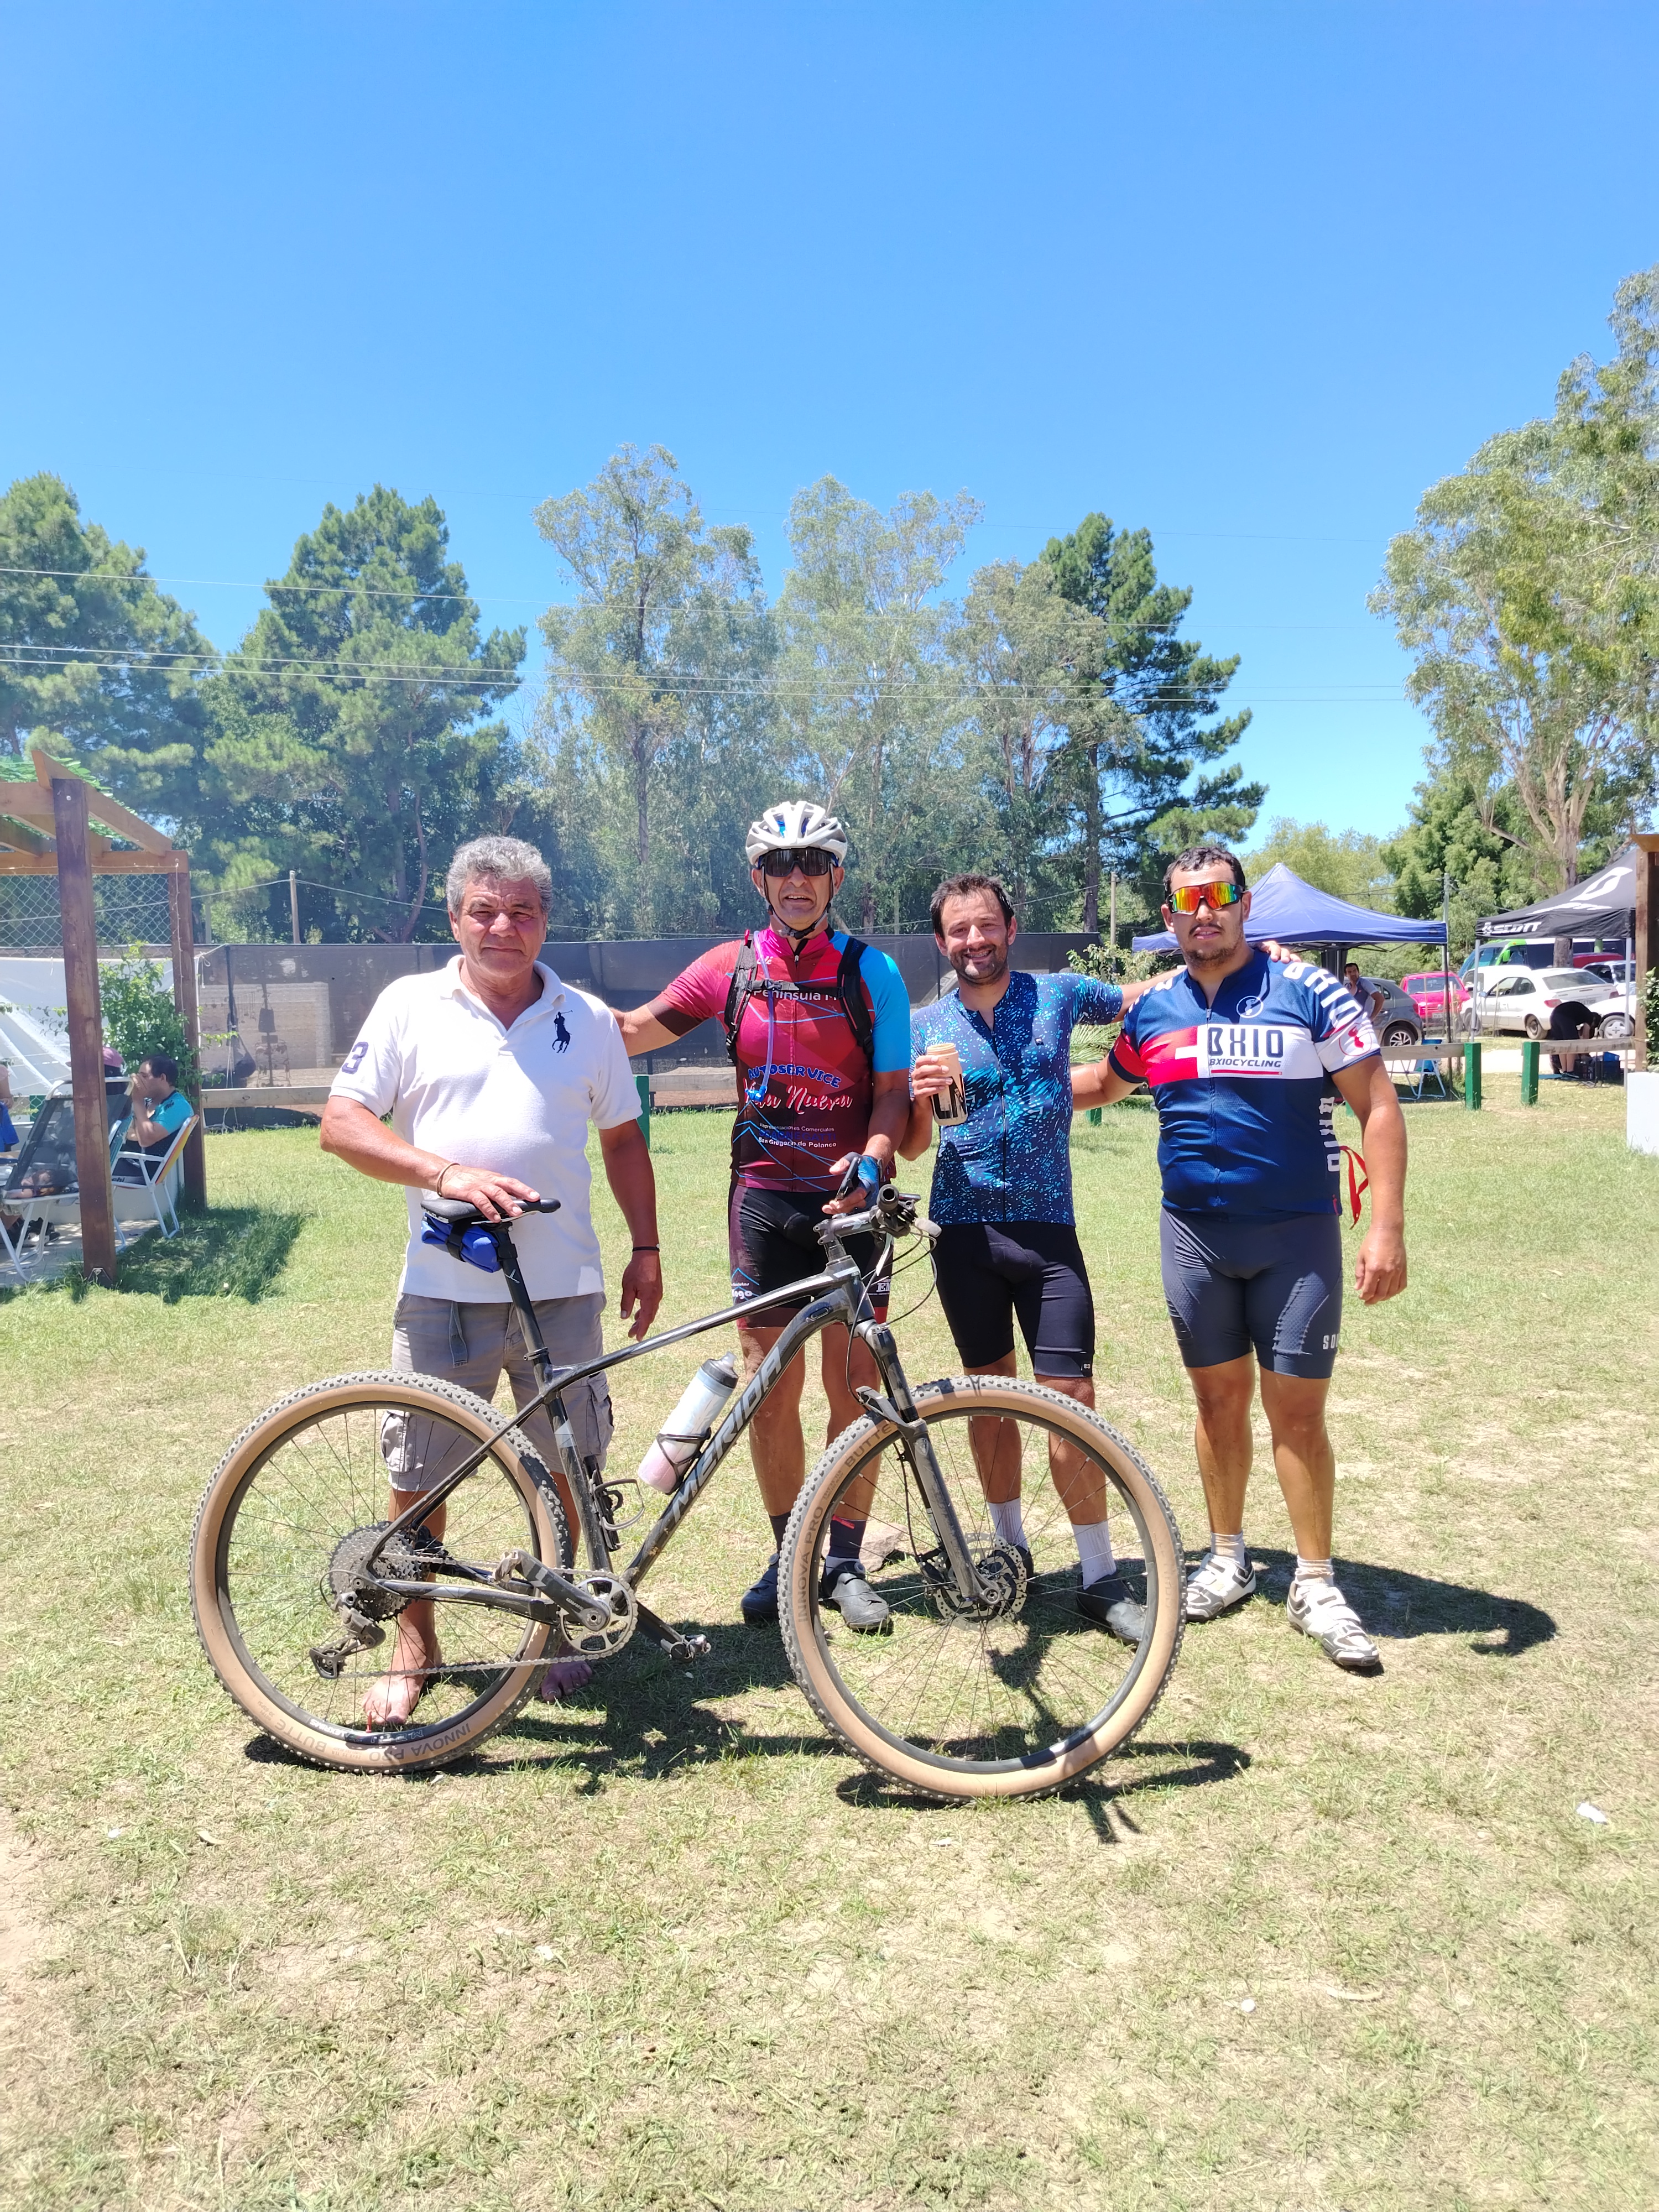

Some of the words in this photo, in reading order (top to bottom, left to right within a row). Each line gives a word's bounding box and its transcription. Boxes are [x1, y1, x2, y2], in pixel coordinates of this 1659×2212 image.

[341, 1041, 369, 1074] 3
[1208, 1027, 1284, 1058] BXIO
[1209, 1058, 1282, 1068] BXIOCYCLING
[785, 1085, 853, 1115] Nueva
[672, 1346, 782, 1521] MERIDA
[844, 1424, 892, 1468] BUTTE
[797, 1551, 811, 1623] INNOVA
[804, 1506, 823, 1544] PRO
[275, 1718, 327, 1753] BUTTE
[411, 1723, 472, 1756] INNOVA
[369, 1748, 404, 1762] PRO
